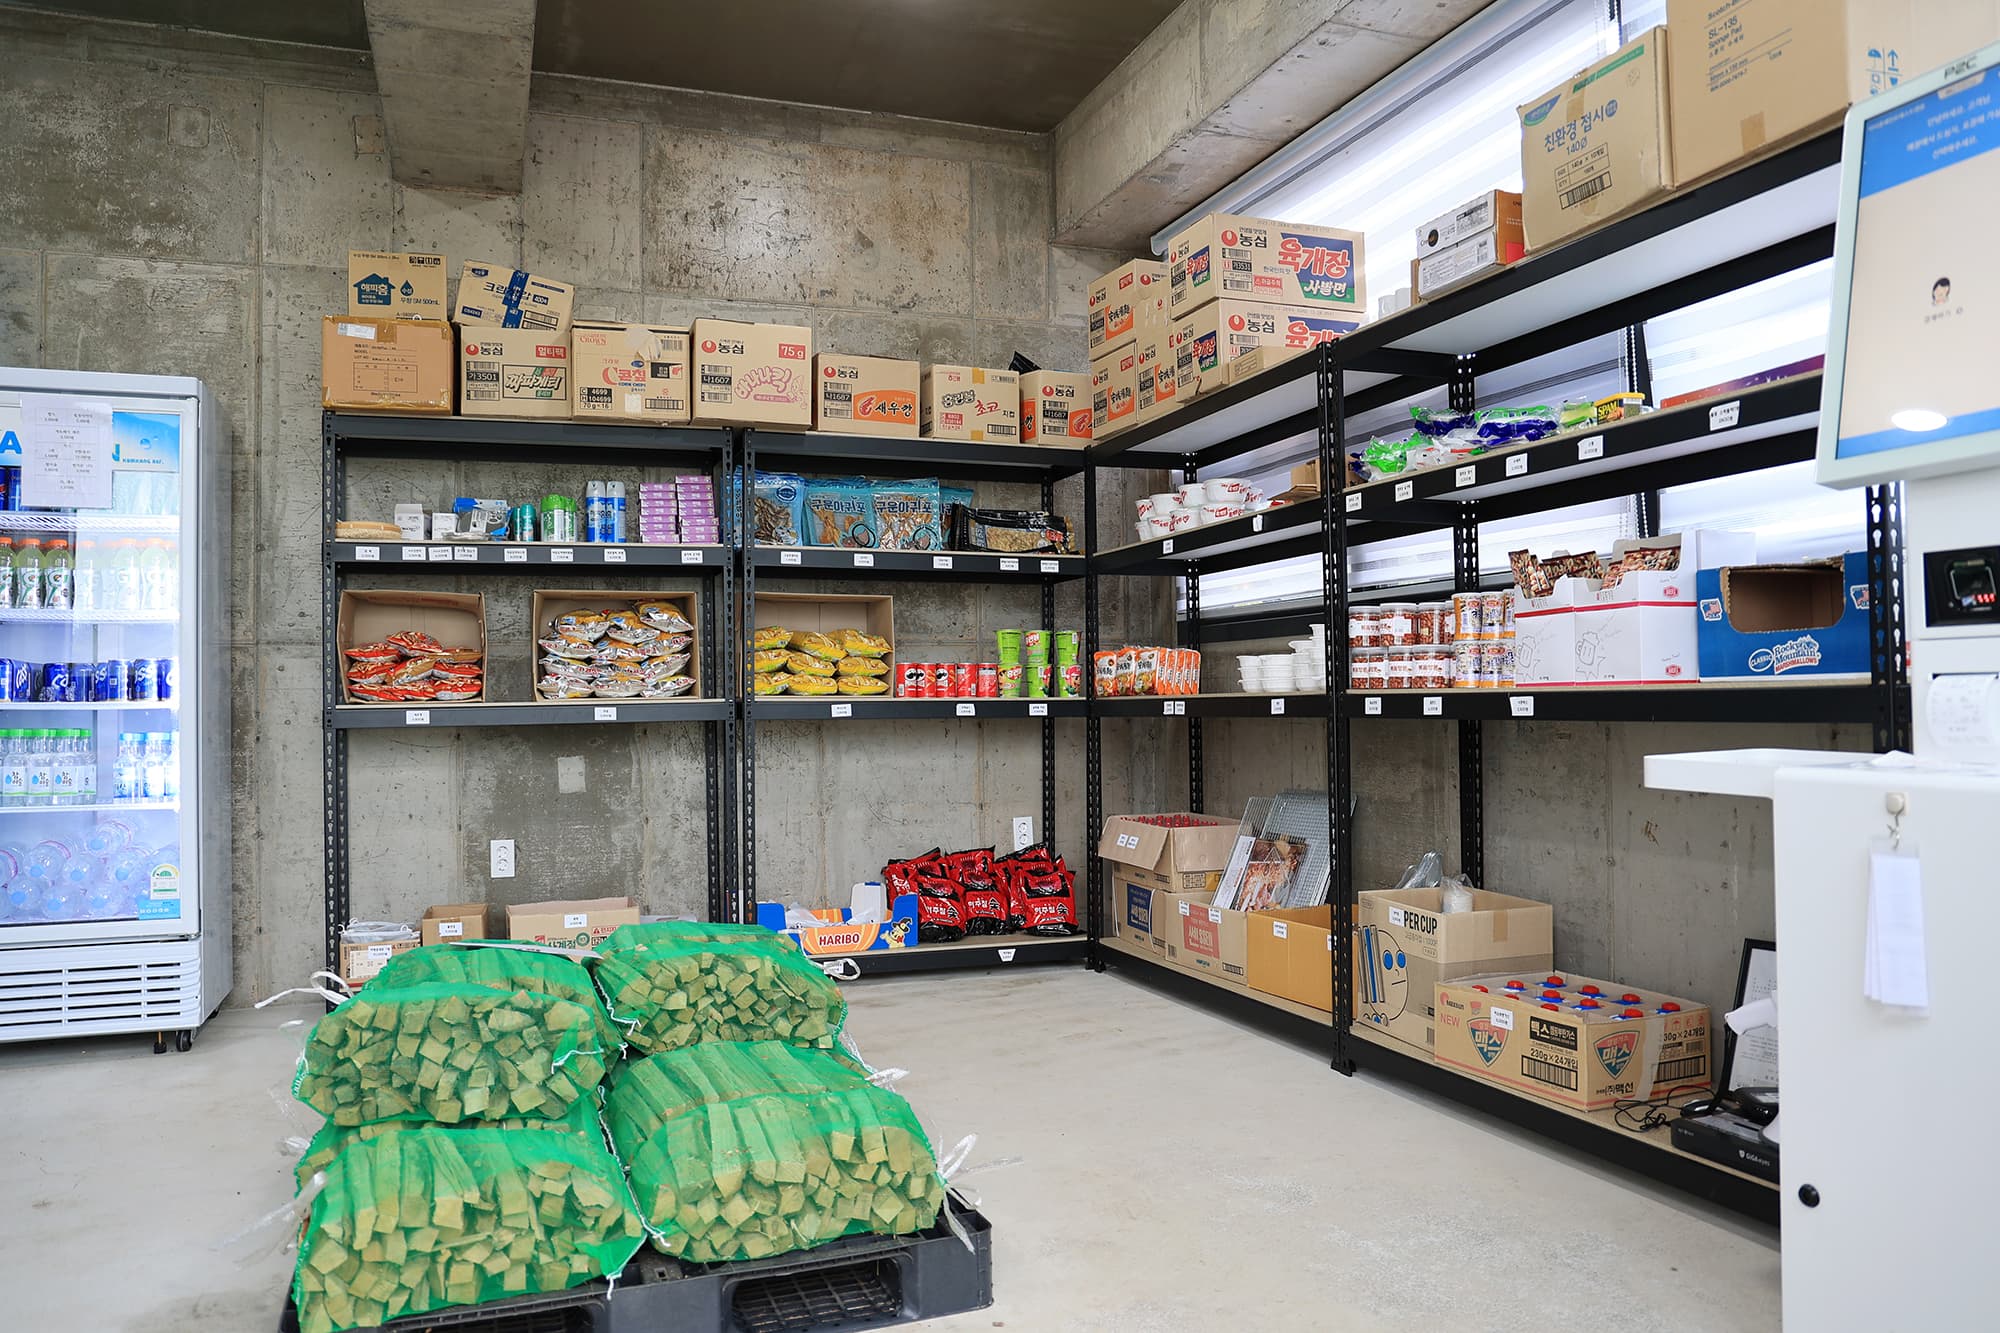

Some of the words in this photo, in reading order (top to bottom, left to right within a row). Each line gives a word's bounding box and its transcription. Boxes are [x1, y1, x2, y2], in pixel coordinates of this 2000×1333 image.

[1709, 15, 1738, 39] SL-135
[1544, 119, 1577, 153] 친환경
[1580, 105, 1604, 133] 접시
[1239, 233, 1268, 249] 농심
[1178, 244, 1190, 258] 농심
[1278, 238, 1351, 279] 육개장
[1186, 251, 1209, 276] 육개장
[360, 283, 389, 296] 해피홈
[1303, 279, 1348, 298] 사발면
[1095, 291, 1107, 304] 농심
[1247, 318, 1275, 334] 농심
[1182, 327, 1194, 341] 농심
[480, 345, 503, 356] 농심
[537, 346, 565, 358] 멀티팩
[718, 343, 744, 355] 농심
[1144, 348, 1157, 361] 농심
[1192, 335, 1216, 360] 육개장
[468, 373, 497, 381] 가3501
[618, 368, 647, 382] 콘칩
[702, 376, 730, 384] 나1607
[837, 368, 859, 379] 농심
[1098, 371, 1109, 384] 농심
[504, 372, 563, 394] 짜파게티
[734, 365, 793, 400] 바나나킥
[1055, 387, 1075, 398] 농심
[875, 401, 913, 418] 새우깡
[974, 400, 1000, 416] 초코
[1597, 401, 1618, 419] SPAM
[810, 499, 868, 513] 구운아귀포
[875, 499, 934, 514] 구운아귀포
[1774, 641, 1803, 657] Rocky
[1775, 647, 1817, 665] Mountain
[1750, 654, 1773, 667] CLASSIC
[1775, 657, 1818, 673] MARSHMALLOWS
[818, 933, 860, 947] HARIBO
[1440, 1013, 1461, 1028] NEW
[1530, 1020, 1550, 1039] 맥스
[1475, 1029, 1503, 1053] 맥스
[1602, 1042, 1631, 1067] 맥스
